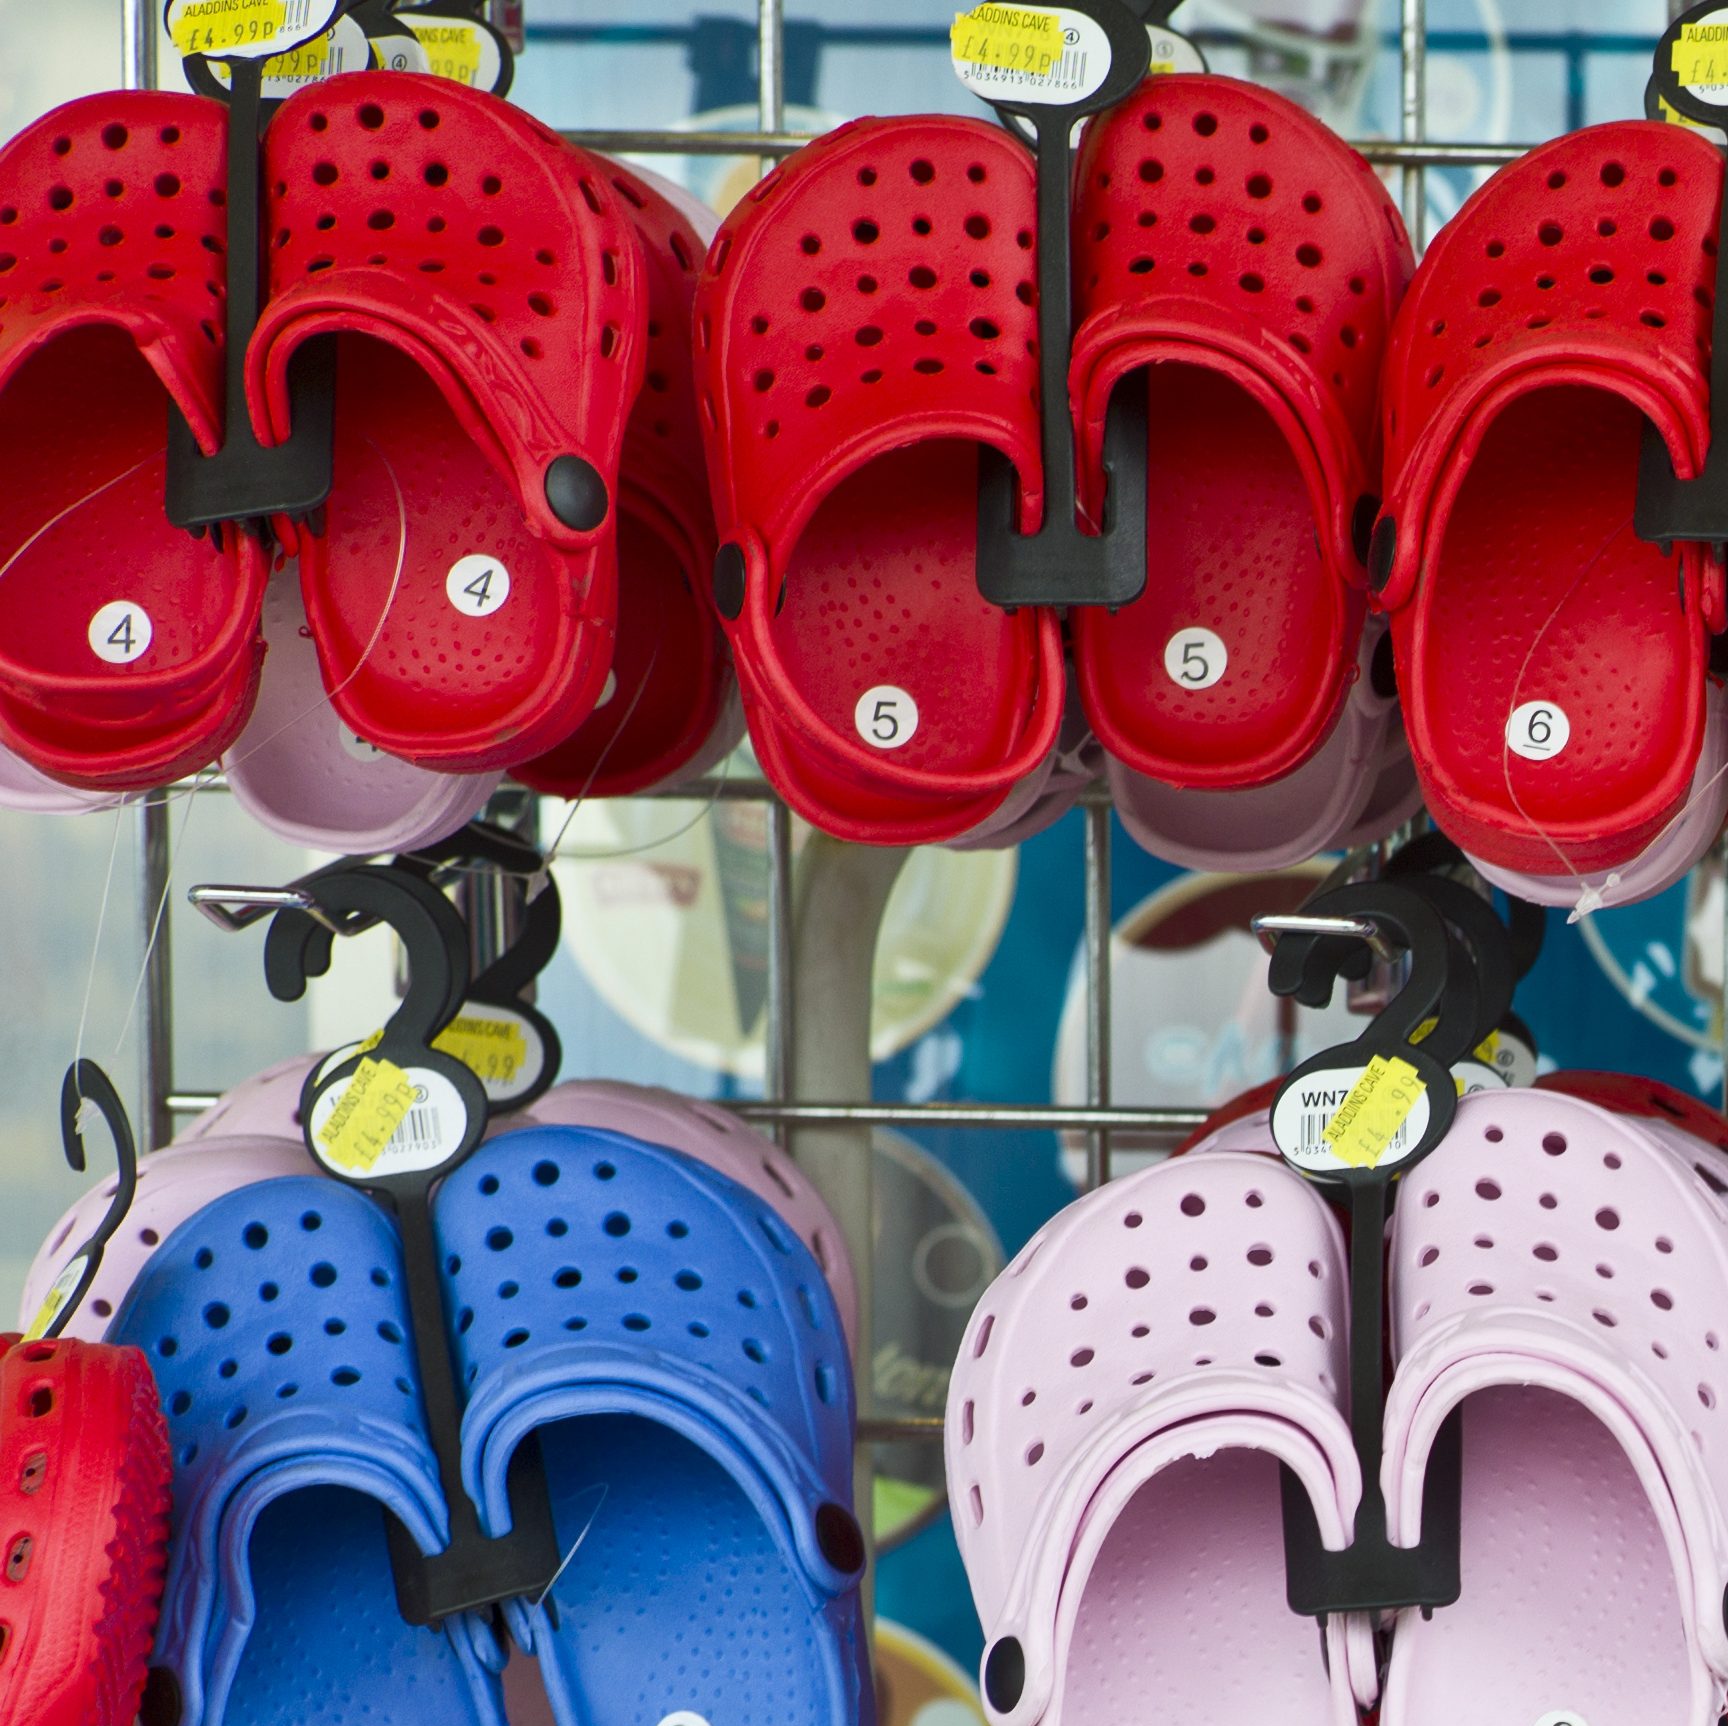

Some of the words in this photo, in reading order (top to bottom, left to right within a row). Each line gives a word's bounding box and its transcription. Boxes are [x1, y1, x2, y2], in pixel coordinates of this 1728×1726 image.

[184, 0, 238, 18] ALADDINS
[1021, 12, 1051, 32] CAVE
[189, 20, 274, 51] £4.99p
[963, 36, 1051, 68] £4.99p
[464, 569, 494, 607] 4
[108, 615, 135, 653] 4
[1181, 642, 1208, 681] 5
[873, 701, 898, 740] 5
[1525, 710, 1552, 746] 6
[322, 1093, 360, 1143] ALADDINS
[352, 1066, 377, 1096] CAVE
[1302, 1091, 1346, 1108] WN7
[1327, 1090, 1367, 1143] ALADDINS
[1363, 1066, 1386, 1094] CAVE
[1358, 1075, 1422, 1158] £4.99
